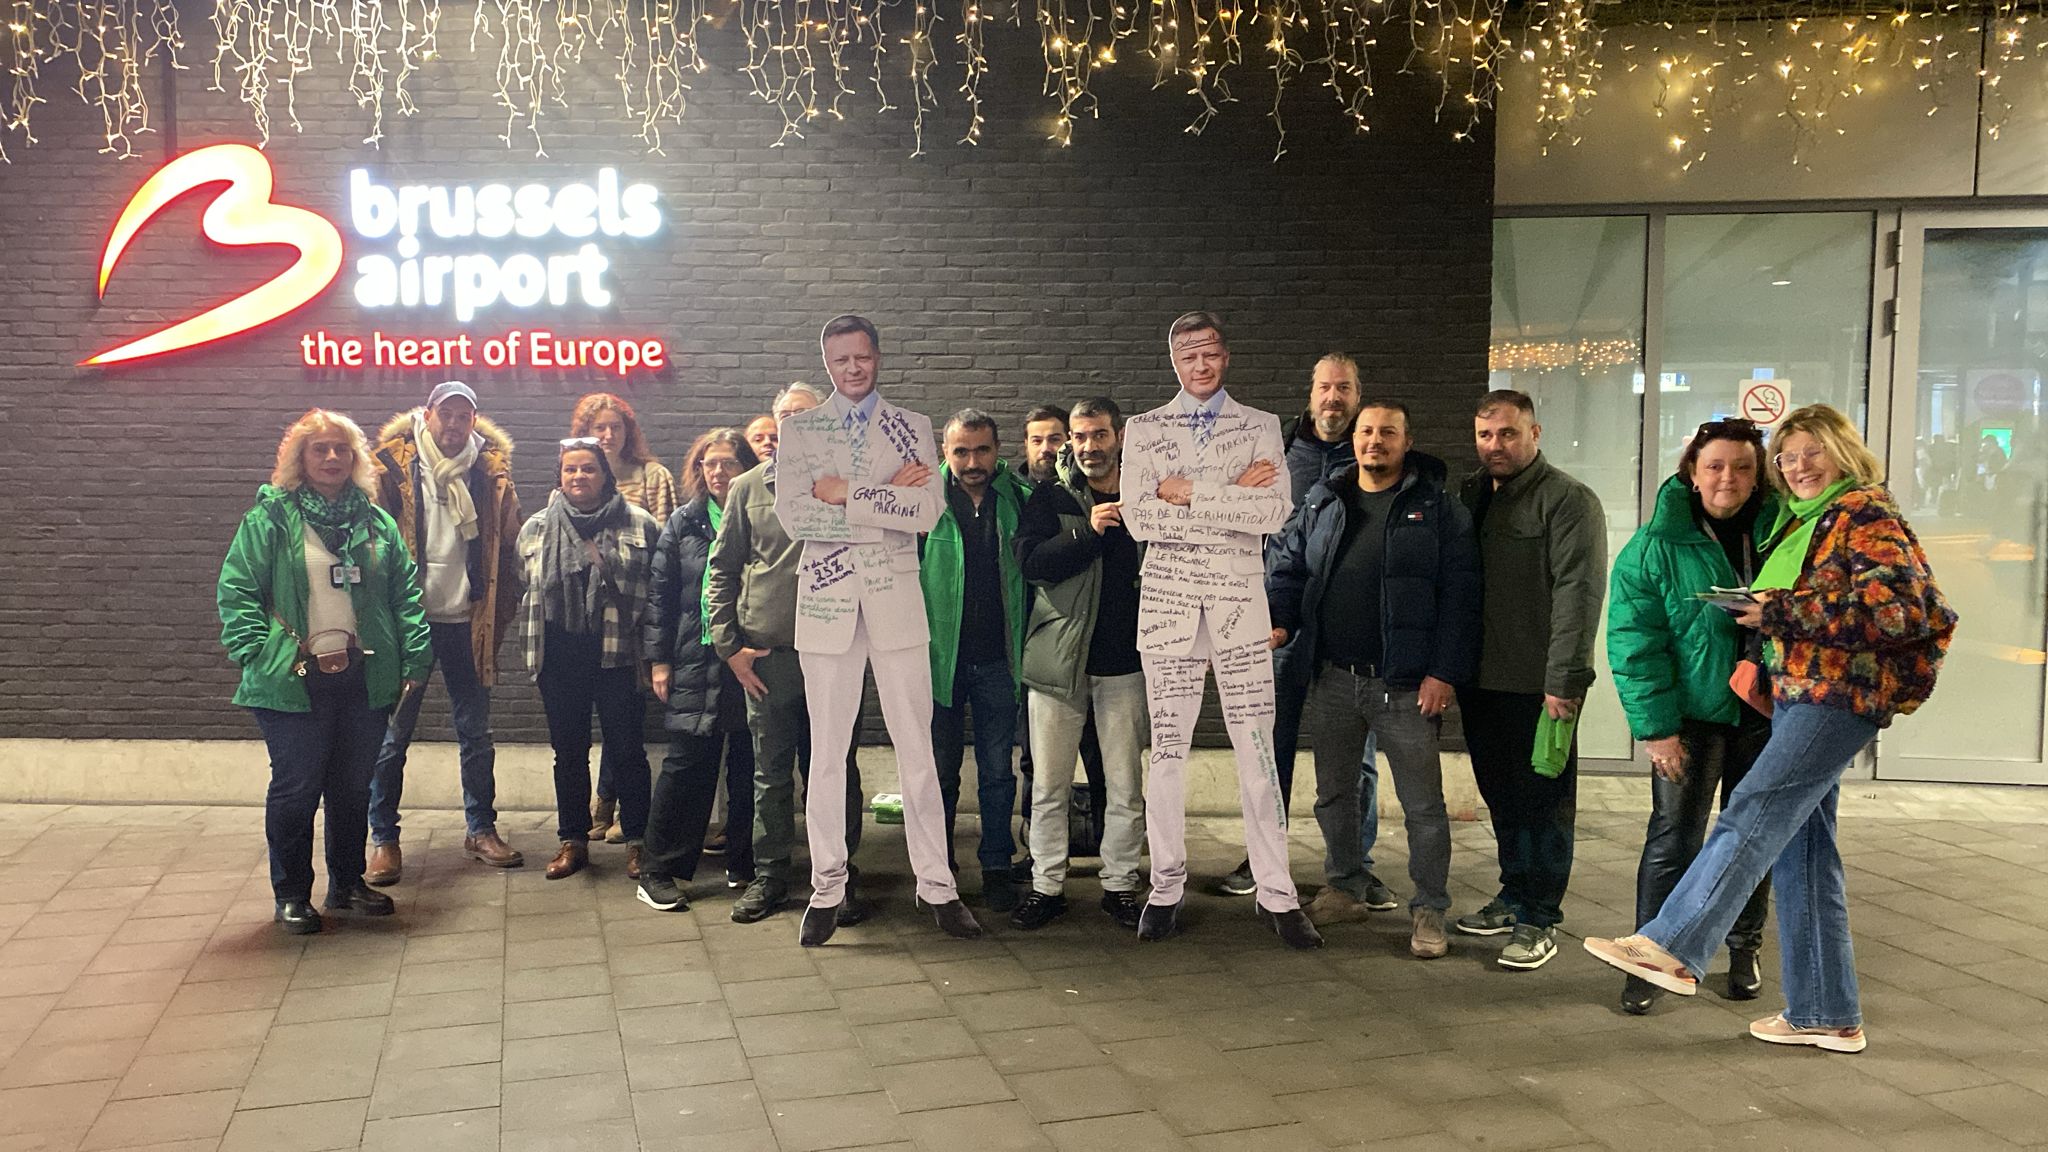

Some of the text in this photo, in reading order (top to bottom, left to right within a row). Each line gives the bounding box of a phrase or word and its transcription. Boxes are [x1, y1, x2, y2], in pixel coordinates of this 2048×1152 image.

[350, 167, 663, 240] brussels
[353, 238, 612, 322] airport
[301, 331, 665, 375] the heart of Europe
[853, 487, 896, 503] GRATIS
[1132, 507, 1153, 521] PAS
[1157, 509, 1171, 520] DE
